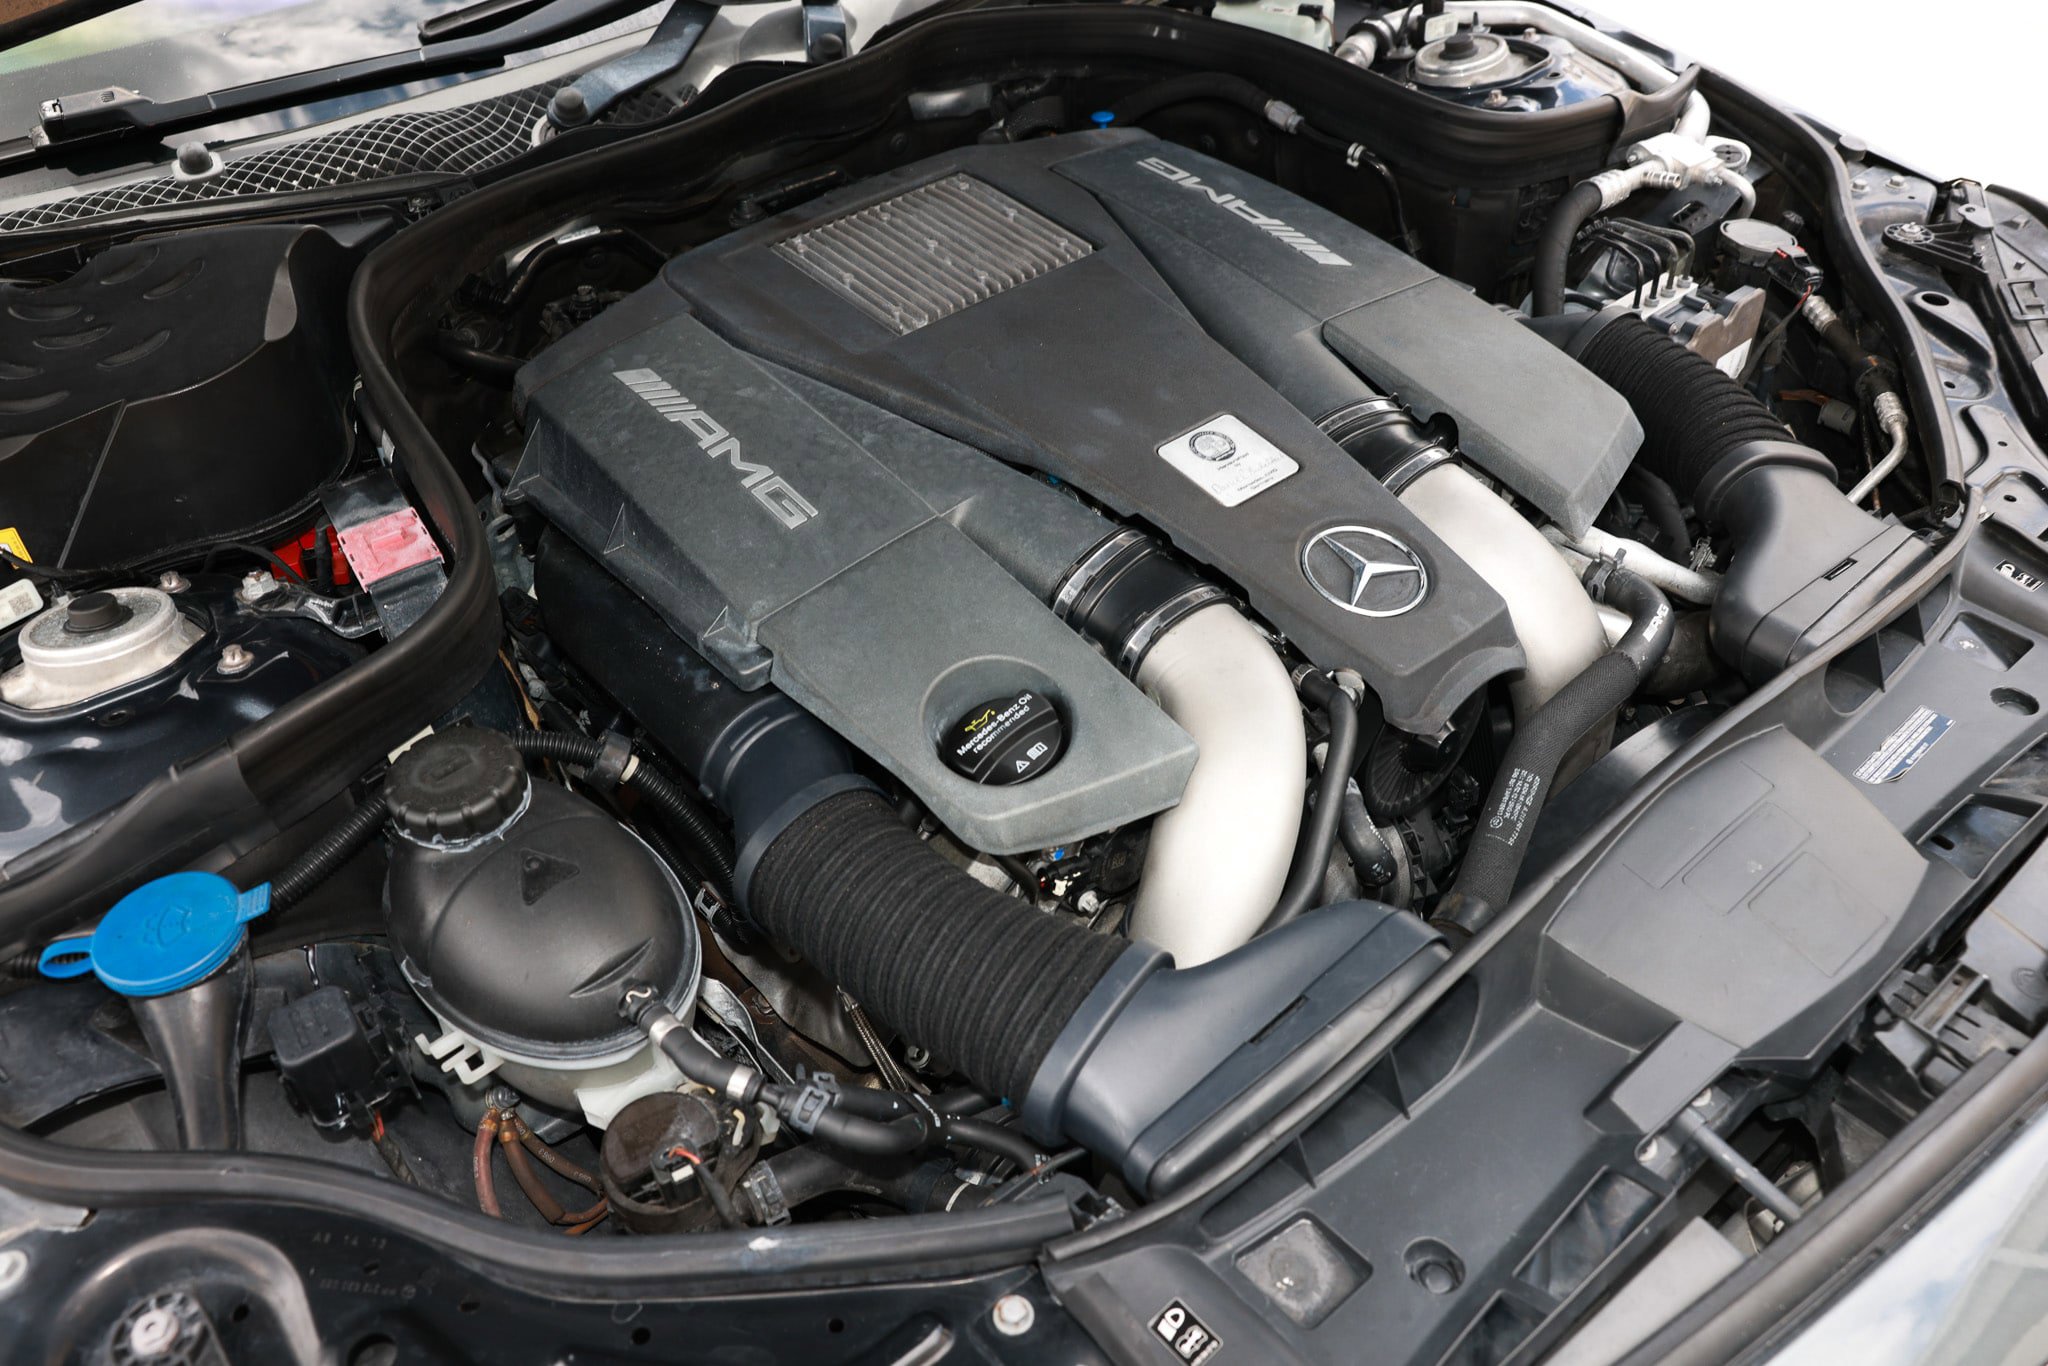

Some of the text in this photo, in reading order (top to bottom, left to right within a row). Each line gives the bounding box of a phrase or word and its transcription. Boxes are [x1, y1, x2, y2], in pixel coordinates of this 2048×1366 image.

[663, 409, 819, 530] AMG
[956, 693, 1033, 756] Mercedes-Benz Oil
[973, 705, 1030, 754] recommended
